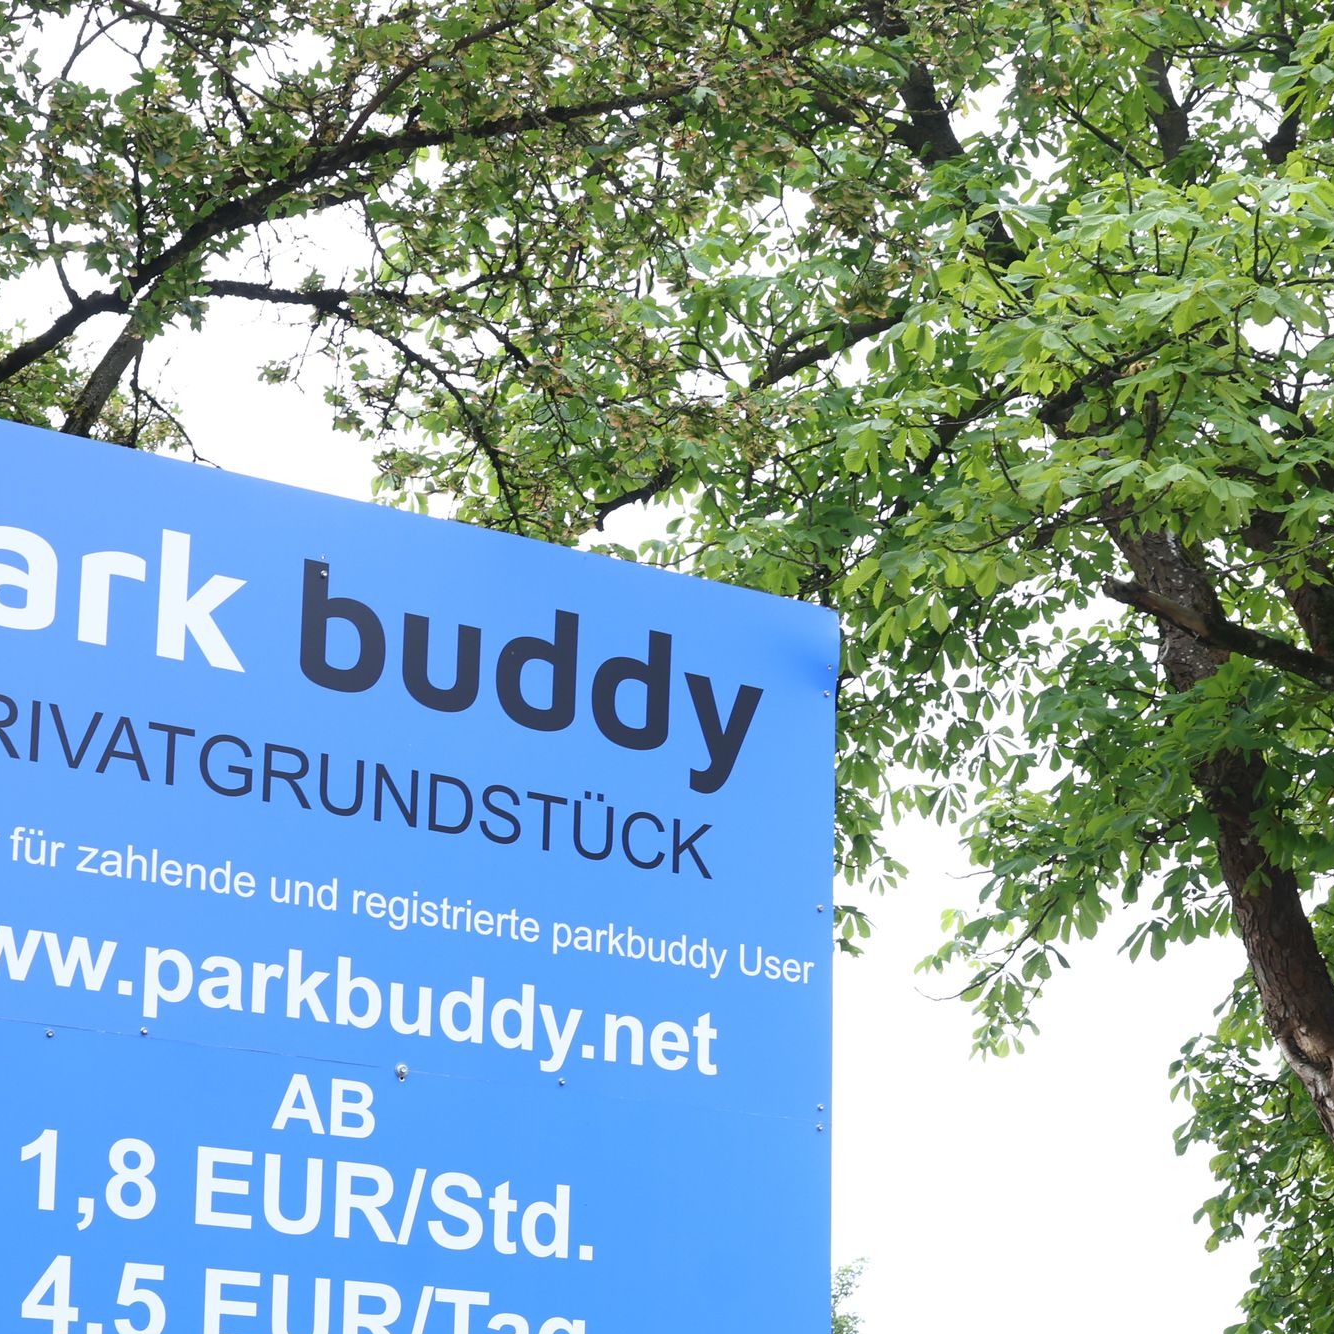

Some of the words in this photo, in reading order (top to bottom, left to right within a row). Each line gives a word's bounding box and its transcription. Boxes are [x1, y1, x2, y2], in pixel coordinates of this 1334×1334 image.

[300, 559, 764, 794] buddy
[9, 826, 66, 867] für
[76, 844, 256, 898] zahlende
[270, 876, 338, 911] und
[352, 890, 540, 943] registrierte
[552, 922, 728, 979] parkbuddy
[739, 943, 815, 984] User
[271, 1073, 376, 1139] AB
[20, 1128, 157, 1231] 1,8
[194, 1145, 594, 1261] EUR/Std.
